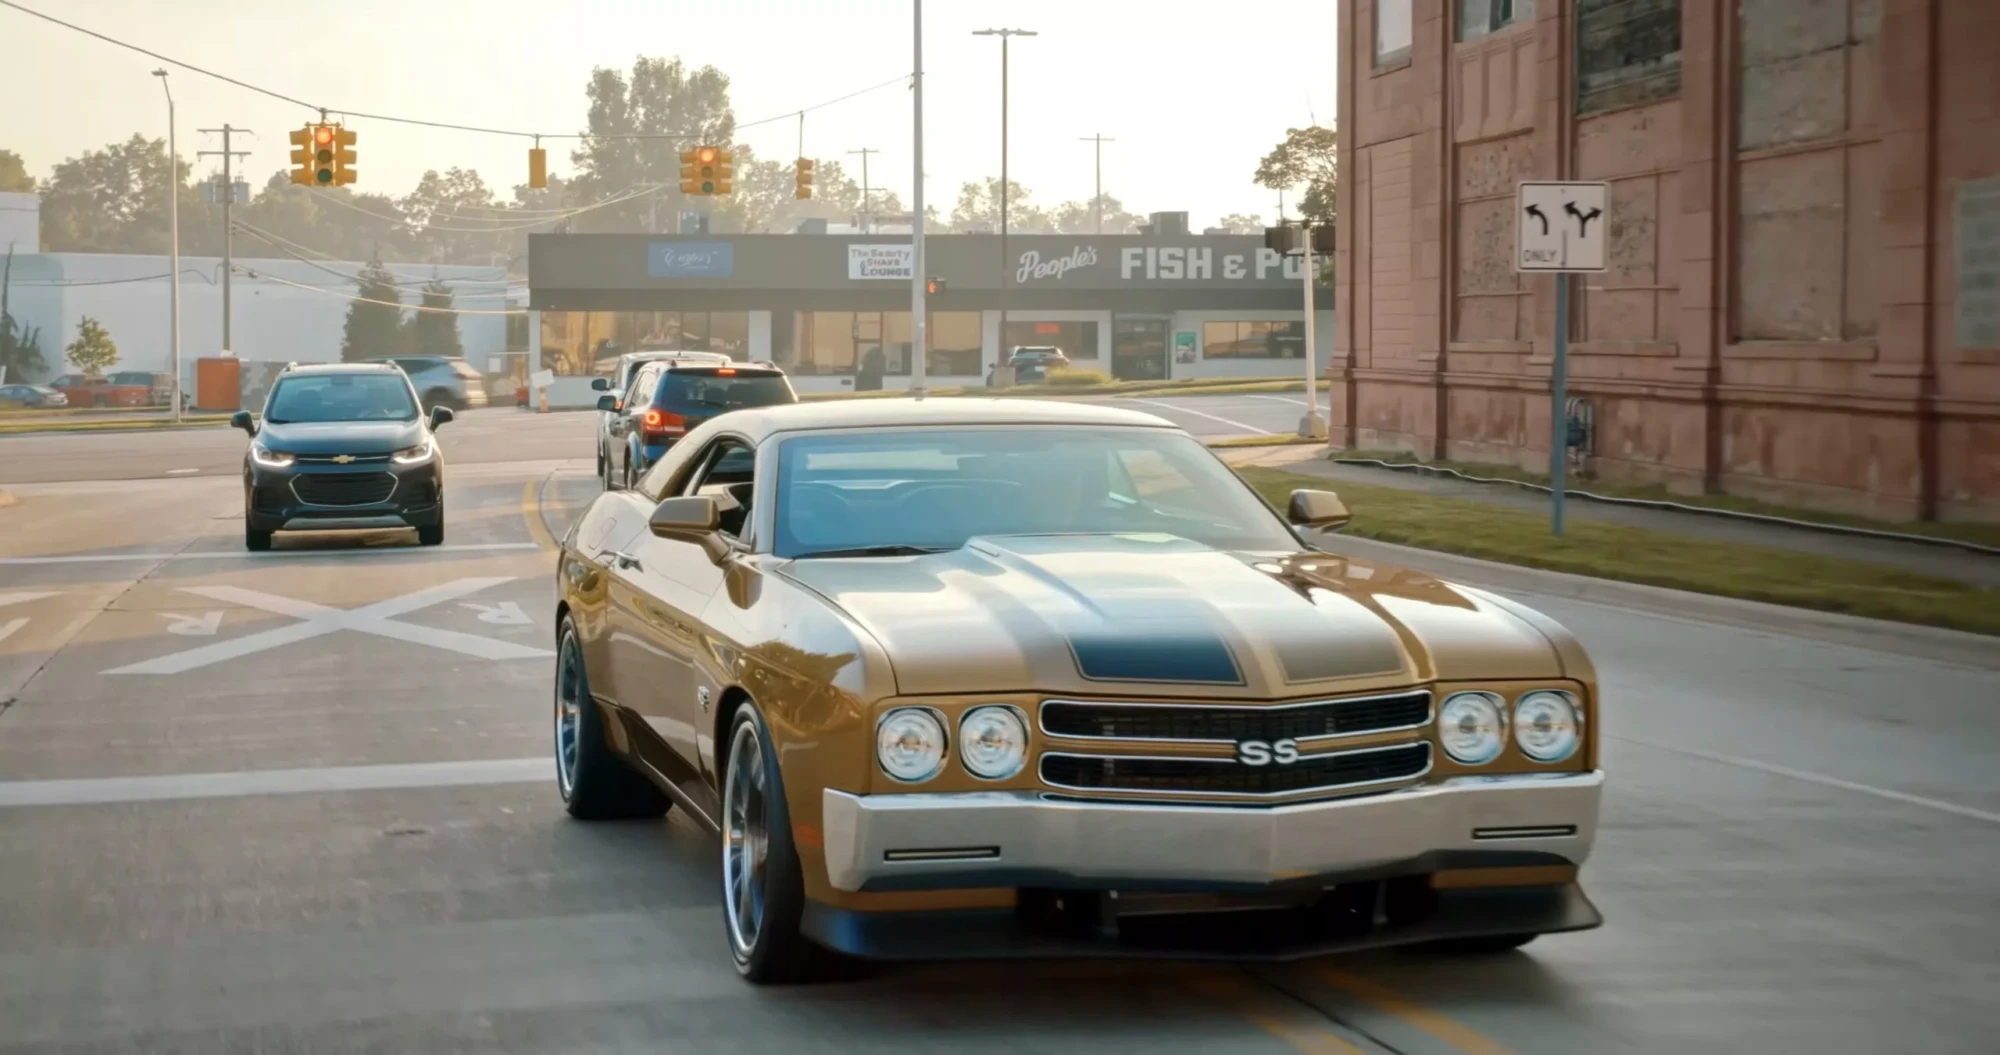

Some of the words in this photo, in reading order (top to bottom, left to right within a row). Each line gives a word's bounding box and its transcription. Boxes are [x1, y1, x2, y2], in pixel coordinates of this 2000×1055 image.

[851, 249, 869, 257] The
[1523, 249, 1558, 262] ONLY
[861, 267, 911, 277] LOUNGE
[1016, 245, 1098, 283] People's
[1121, 247, 1213, 280] FISH
[1223, 254, 1247, 280] &
[1239, 738, 1299, 766] SS
